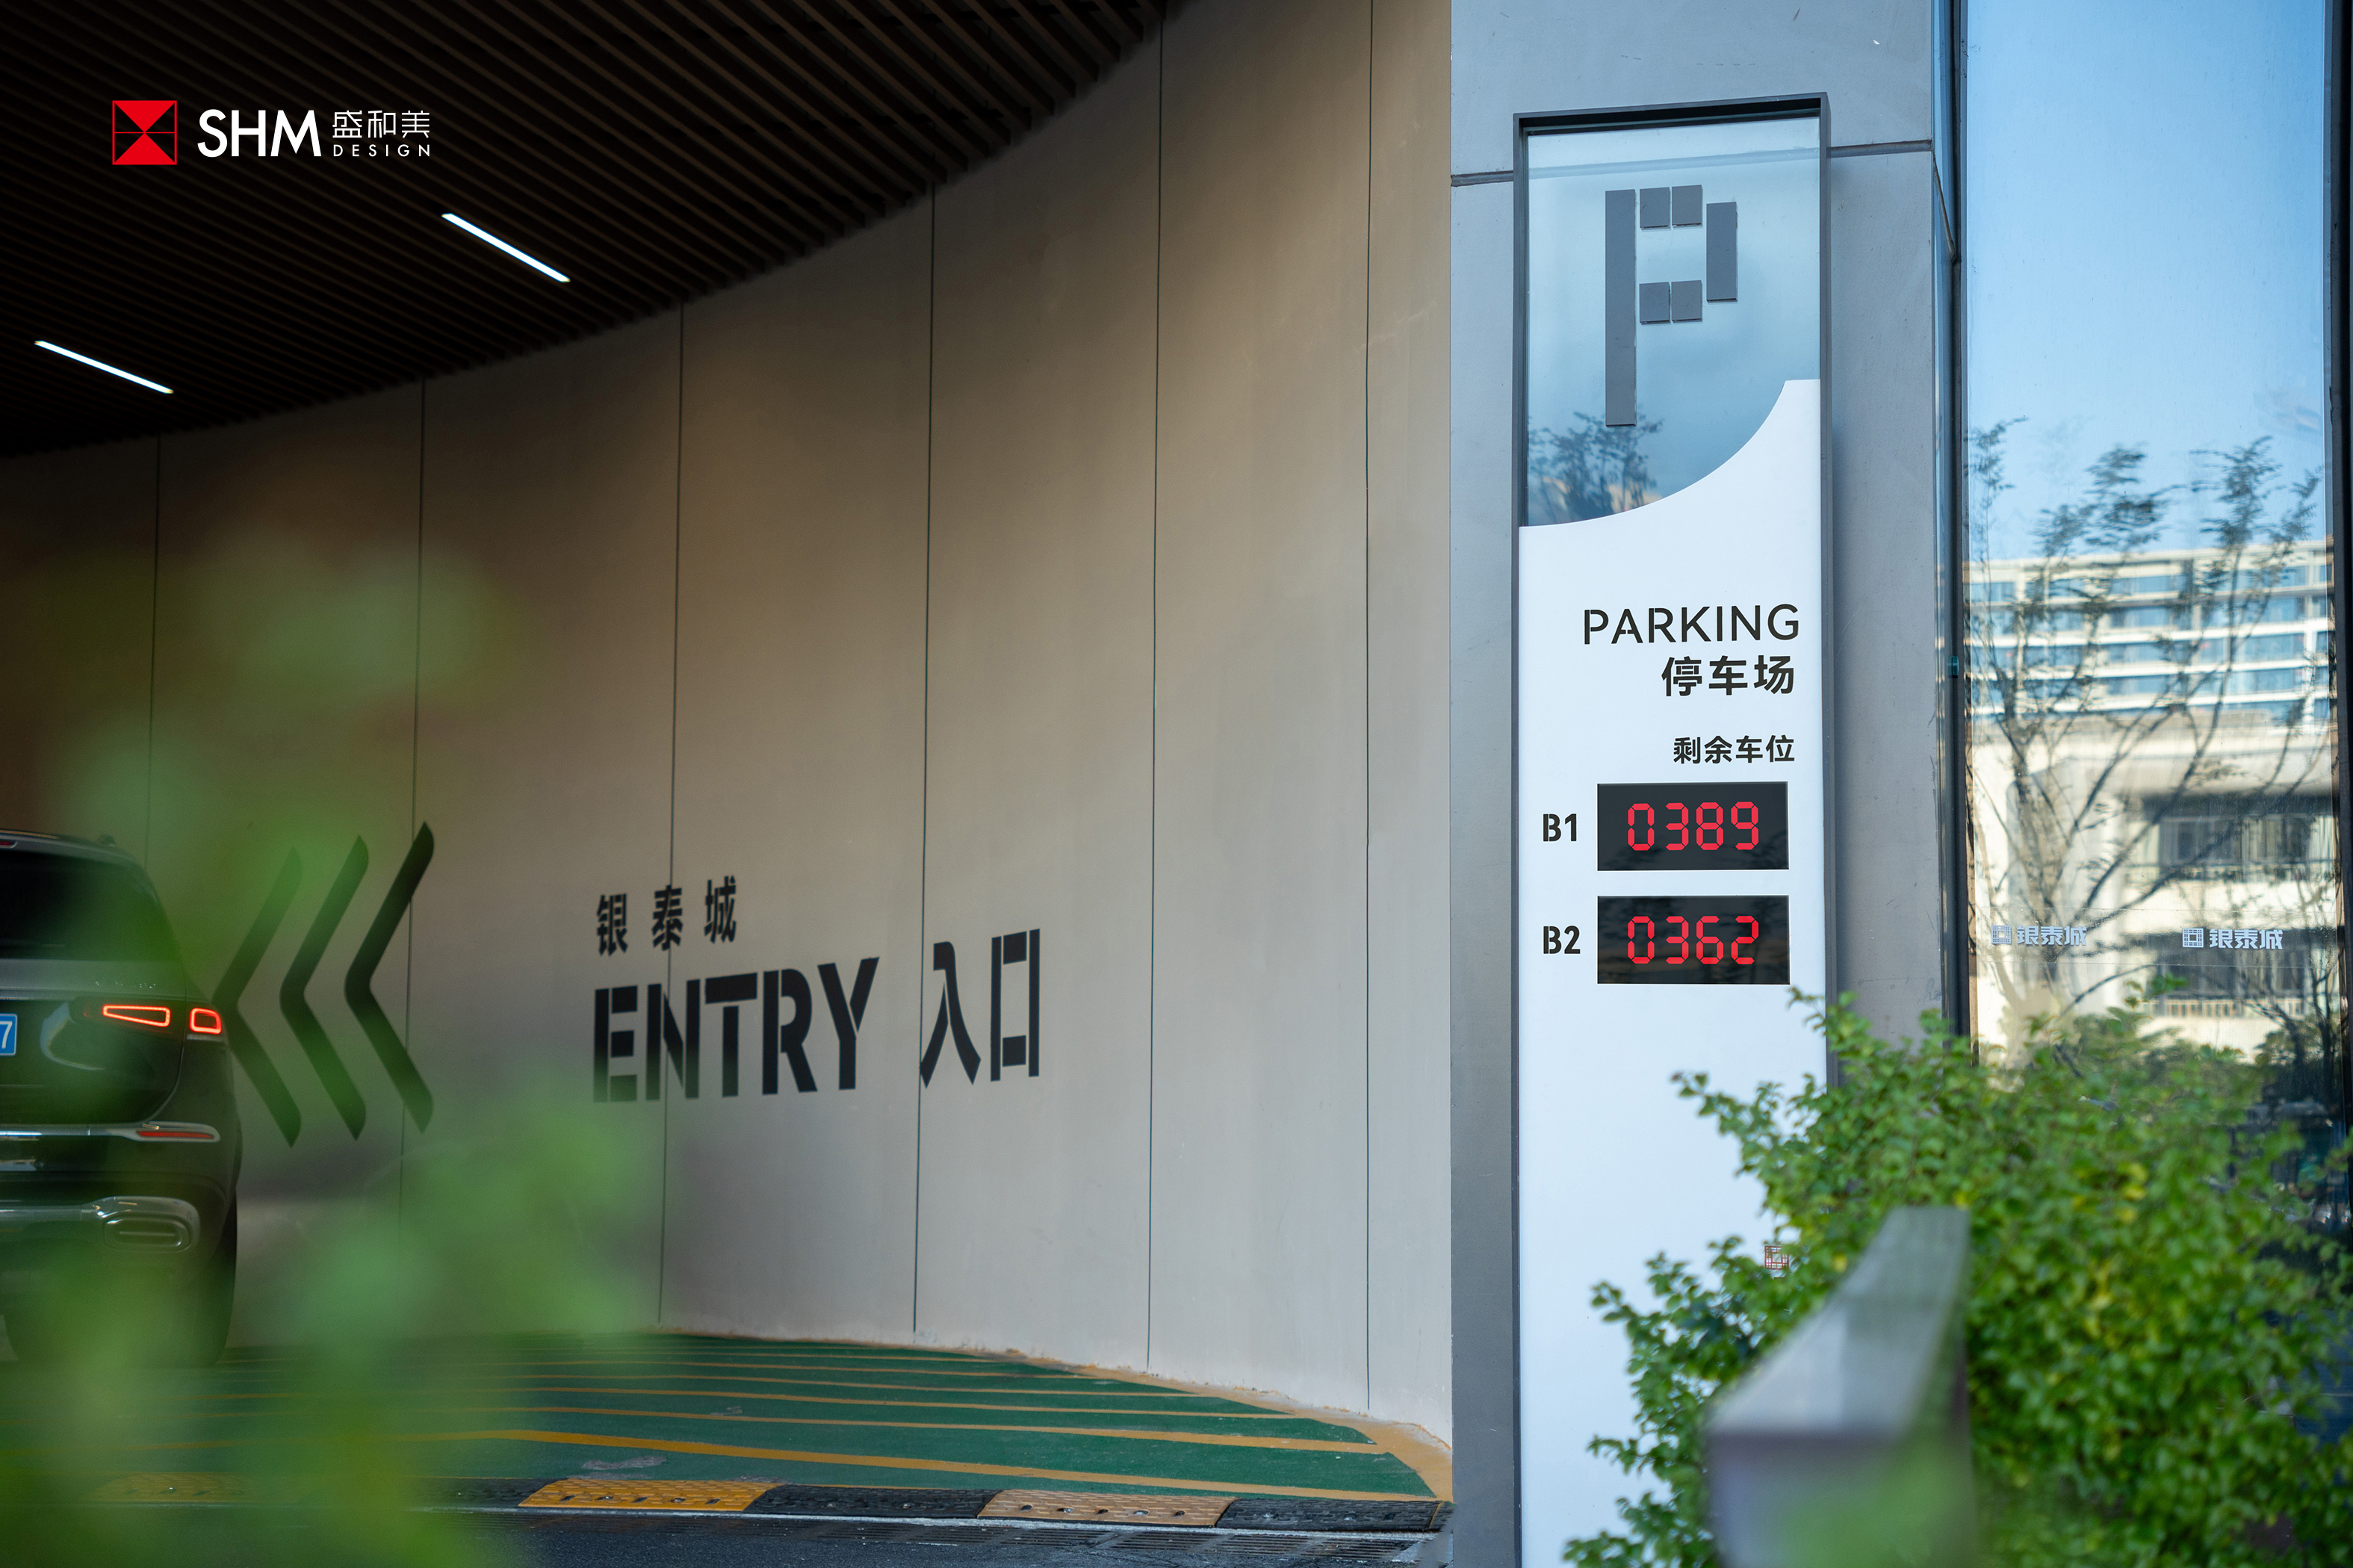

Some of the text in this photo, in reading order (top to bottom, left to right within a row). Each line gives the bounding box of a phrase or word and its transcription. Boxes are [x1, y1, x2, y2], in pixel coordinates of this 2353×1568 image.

[1584, 604, 1799, 645] PARKING
[1661, 654, 1794, 697] 停车场
[1673, 734, 1795, 764] 剩余车位
[1543, 813, 1578, 842] B1
[1627, 801, 1759, 851] 0389
[596, 875, 737, 957] 银泰城
[2017, 925, 2087, 946] 银泰城
[1543, 926, 1581, 955] B2
[1627, 915, 1759, 965] 0362
[2209, 929, 2283, 950] 银泰城
[593, 928, 1041, 1103] ENTRY 入口
